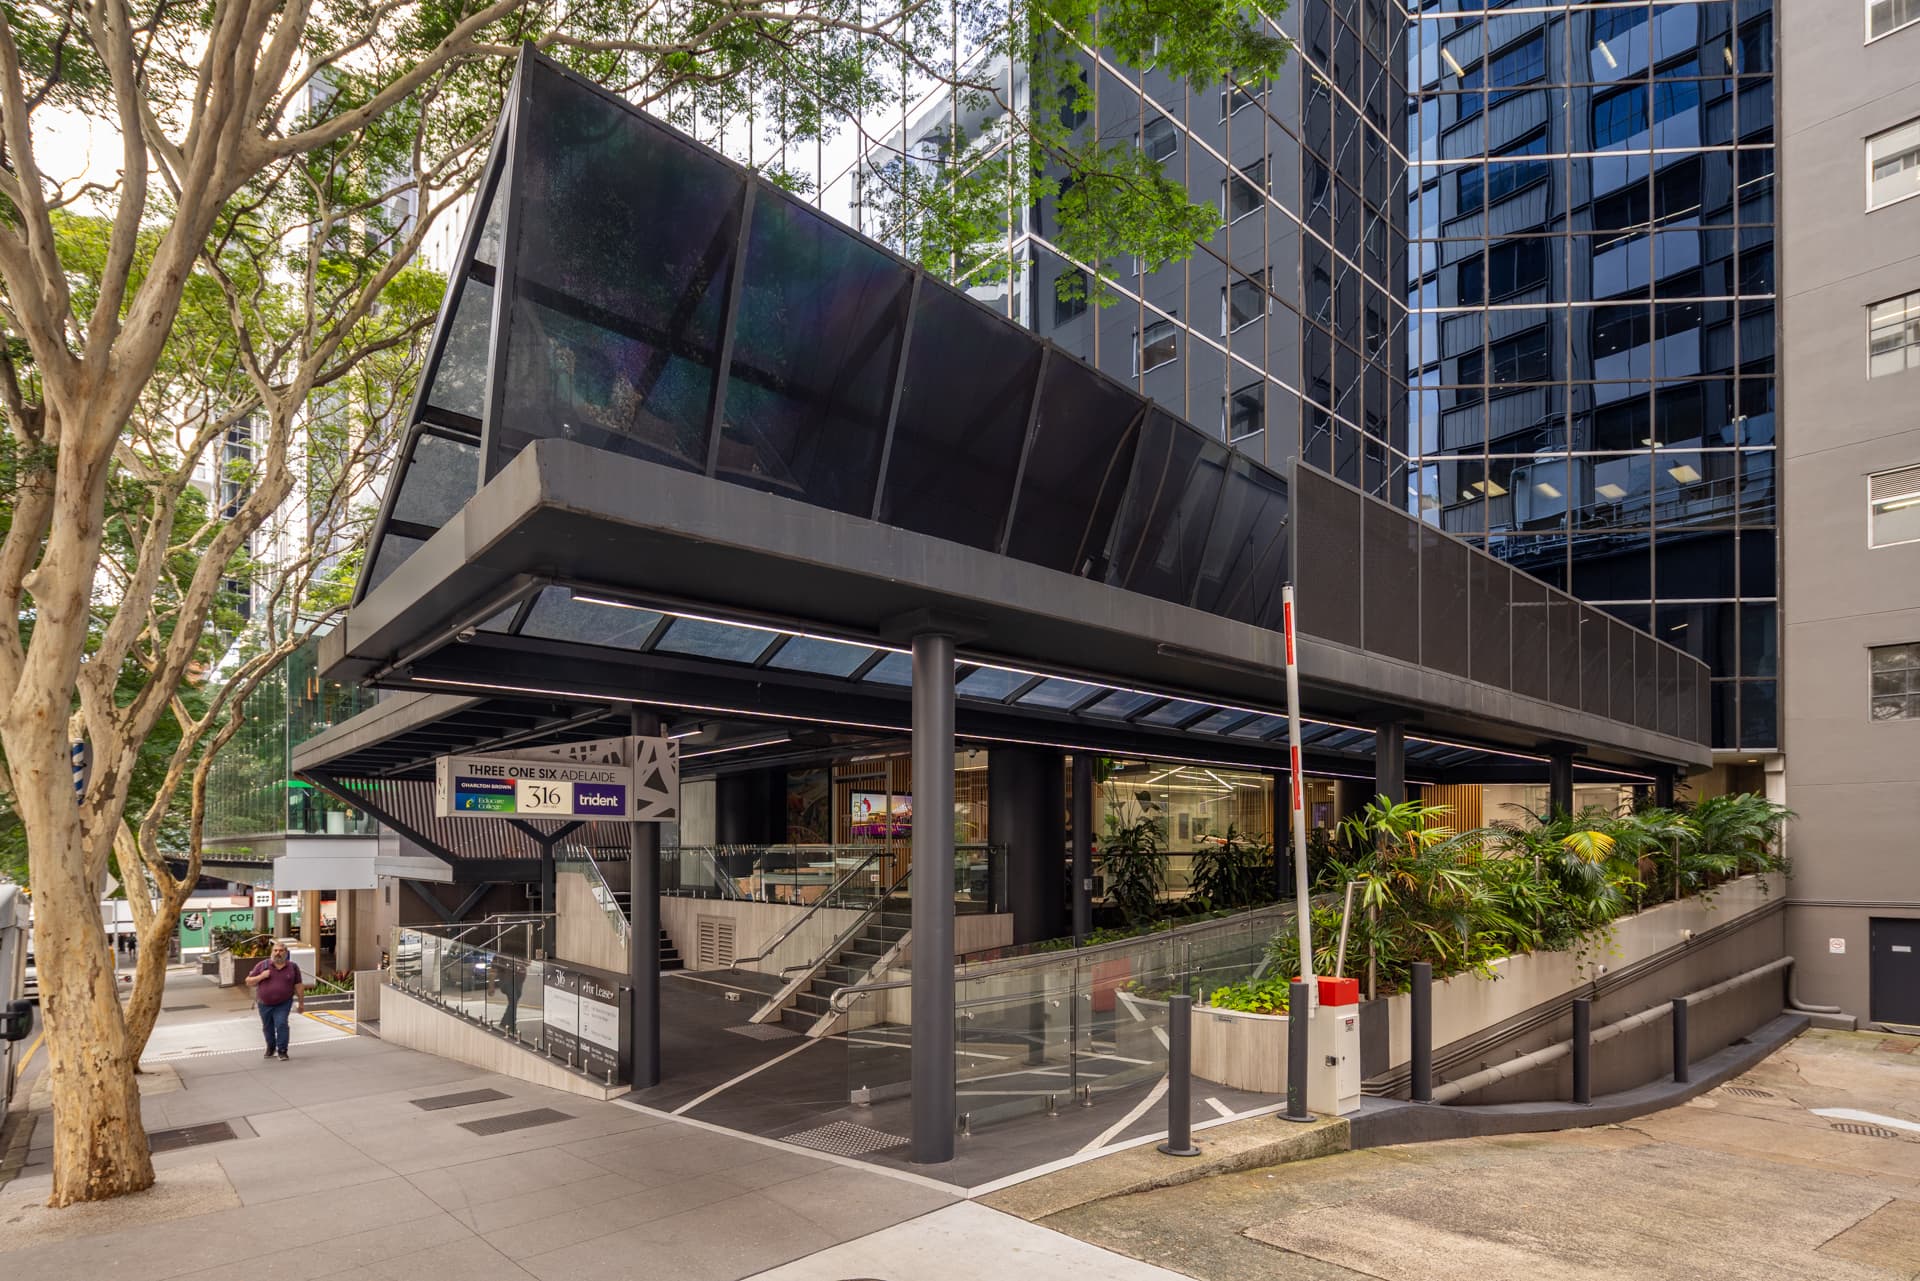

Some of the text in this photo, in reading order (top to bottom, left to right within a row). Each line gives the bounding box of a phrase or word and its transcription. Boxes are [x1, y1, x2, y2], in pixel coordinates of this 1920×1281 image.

[468, 764, 616, 782] THREE ONE SIX ADELAIDE
[525, 785, 561, 808] 316
[579, 793, 618, 807] trident
[554, 969, 566, 986] 316
[585, 981, 595, 995] For
[595, 983, 613, 1000] Lease
